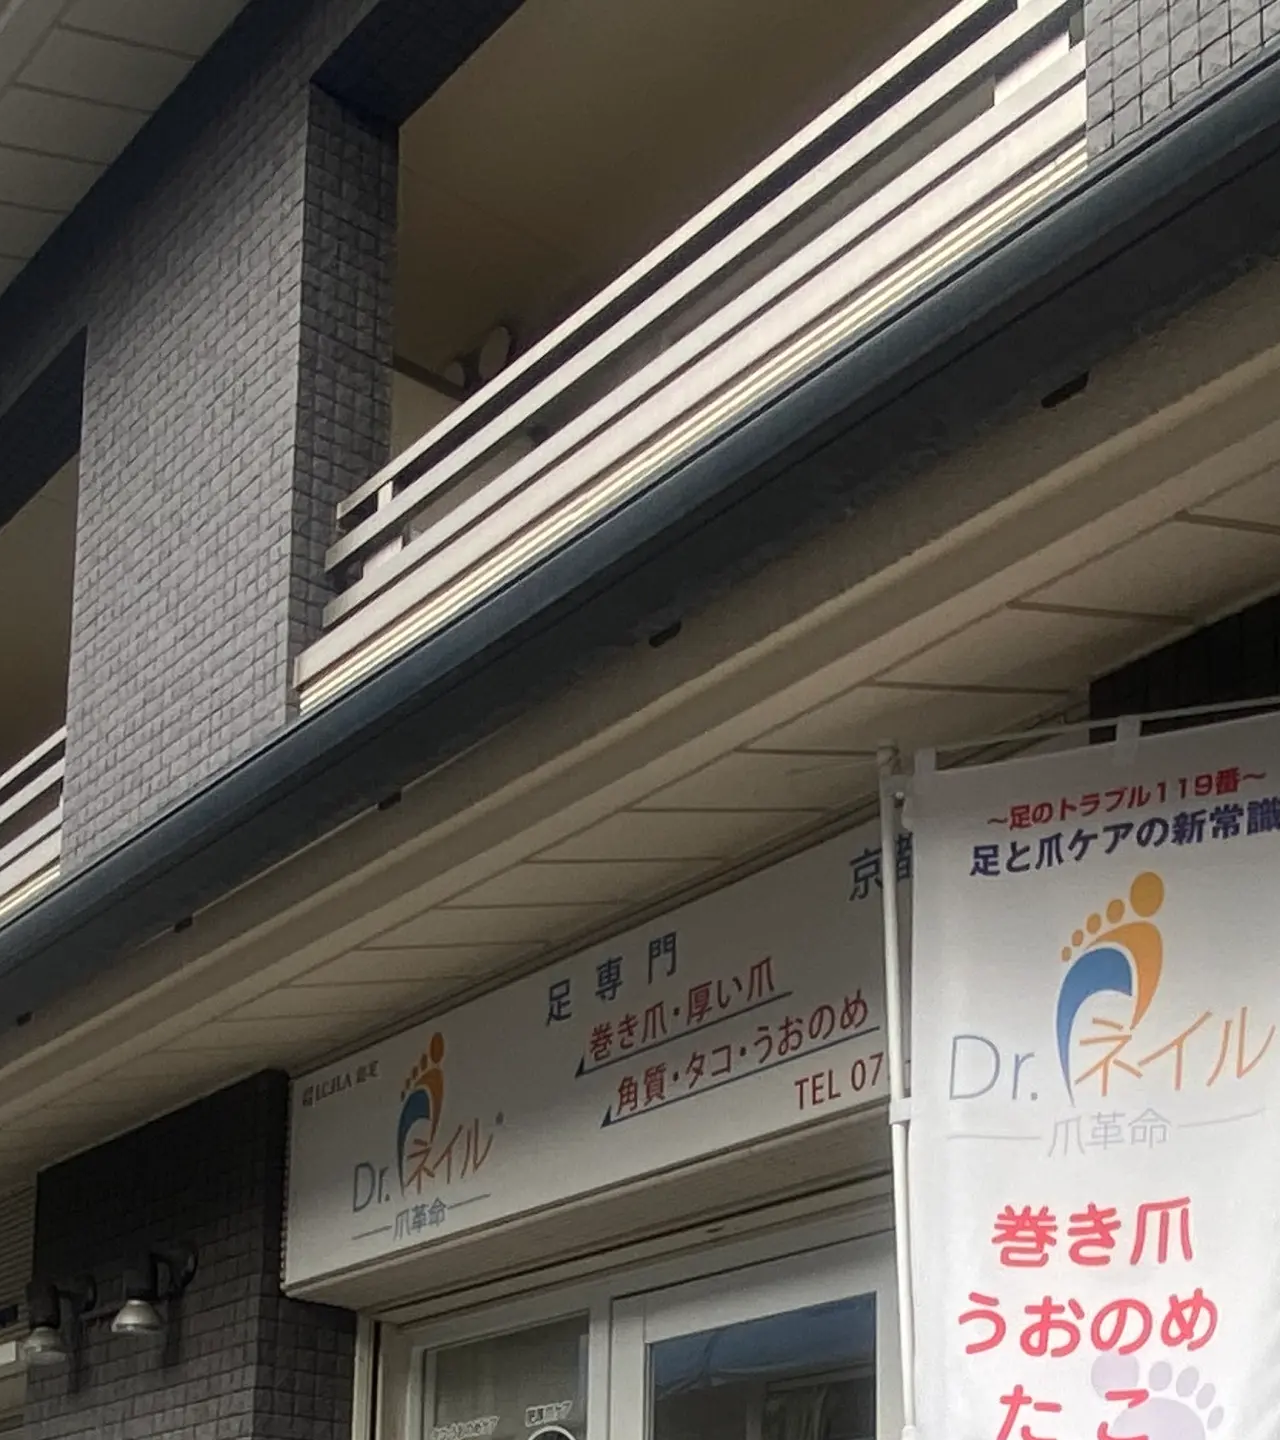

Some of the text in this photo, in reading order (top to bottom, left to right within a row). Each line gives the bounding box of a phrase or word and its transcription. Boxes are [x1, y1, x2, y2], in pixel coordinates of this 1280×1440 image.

[794, 1051, 884, 1111] TEL 07
[1048, 1108, 1172, 1158] 爪革命
[394, 1197, 446, 1240] 爪革命
[991, 1196, 1193, 1267] 巻き爪
[958, 1288, 1218, 1358] うおのめ
